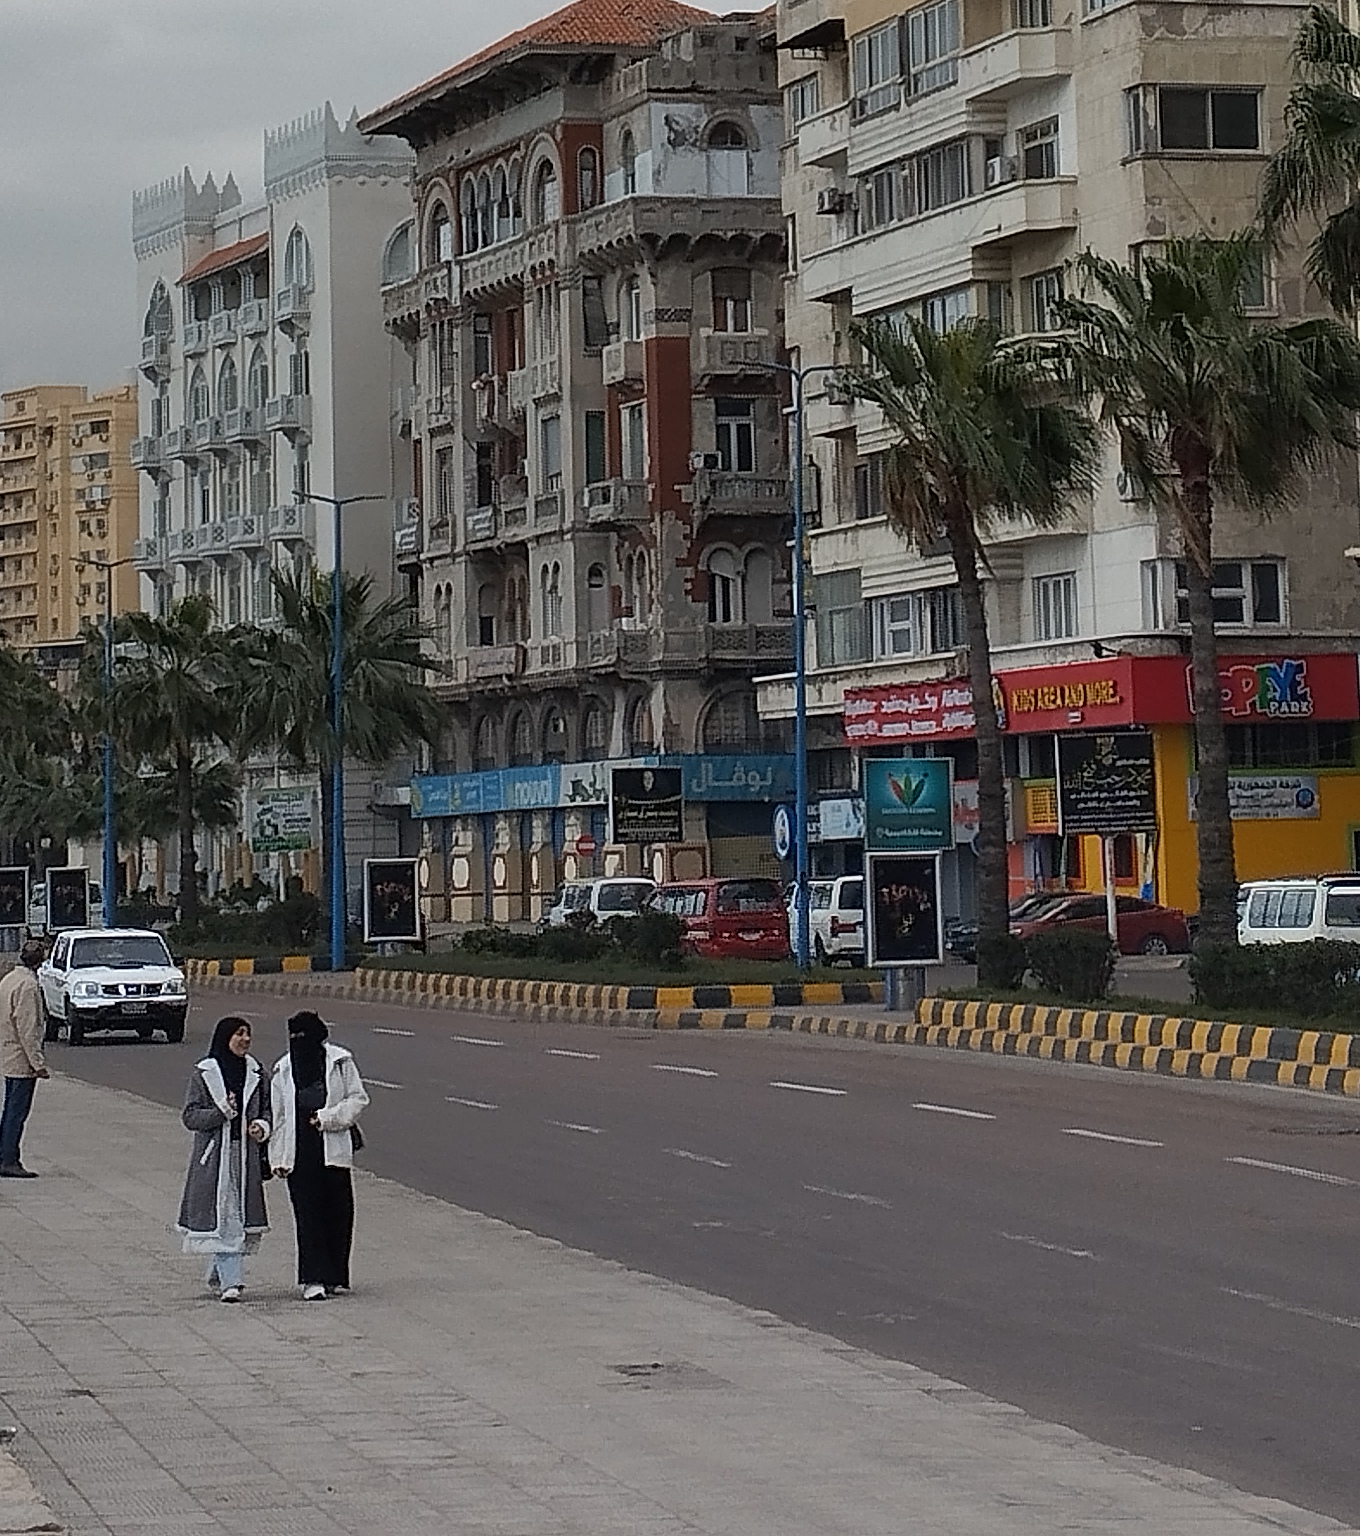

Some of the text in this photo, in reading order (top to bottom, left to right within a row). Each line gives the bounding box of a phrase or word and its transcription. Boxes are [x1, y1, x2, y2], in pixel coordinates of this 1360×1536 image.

[1011, 688, 1035, 714] KIDS
[1036, 686, 1063, 710] AREA
[1064, 683, 1085, 707] AND
[1185, 659, 1310, 716] OPEYE
[1269, 700, 1309, 714] PARK
[1237, 779, 1302, 792] شركة الجمهورية
